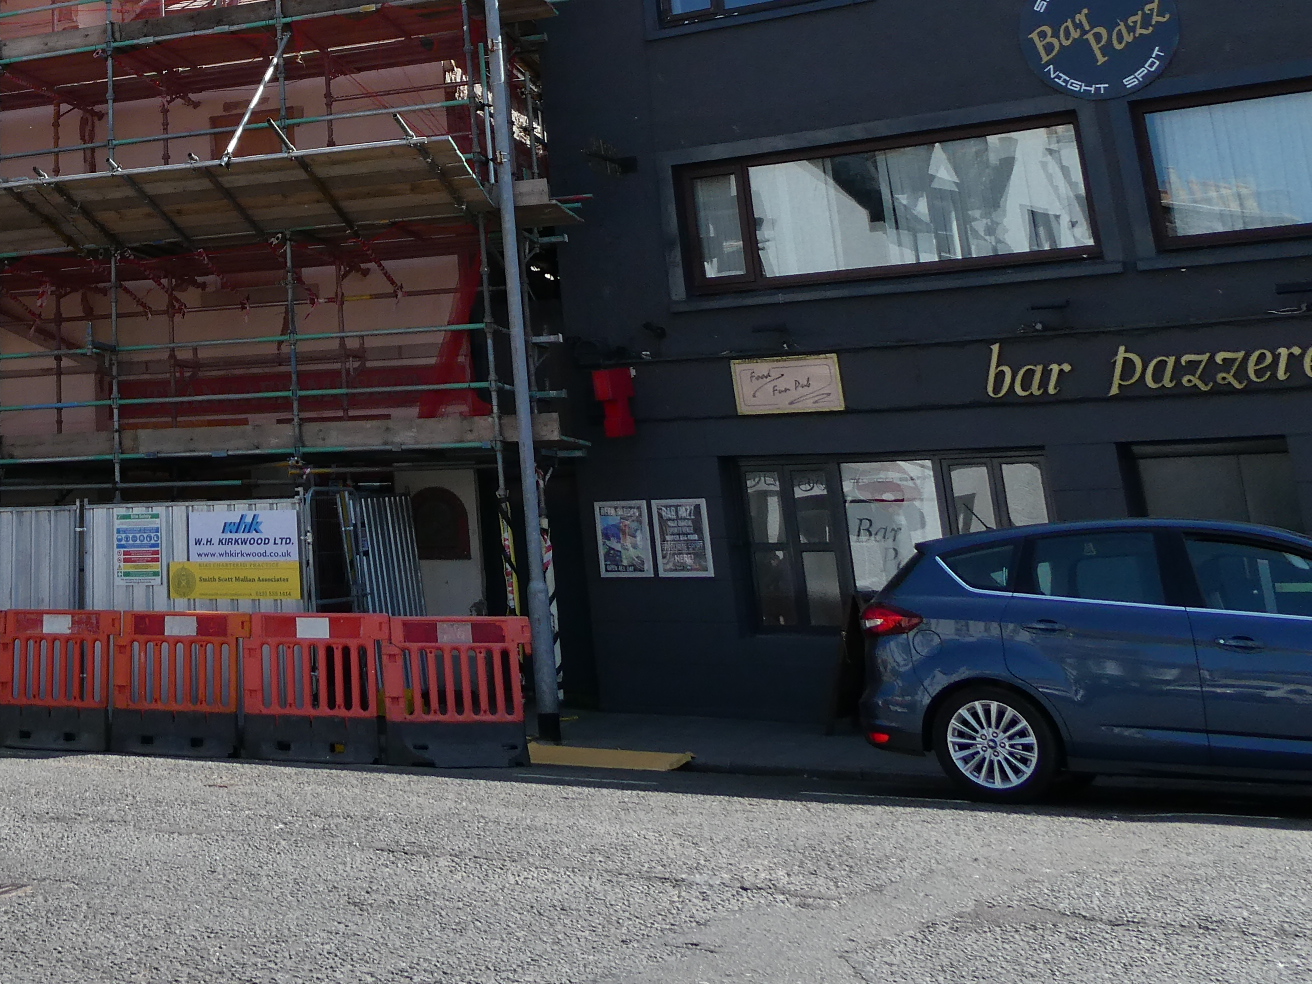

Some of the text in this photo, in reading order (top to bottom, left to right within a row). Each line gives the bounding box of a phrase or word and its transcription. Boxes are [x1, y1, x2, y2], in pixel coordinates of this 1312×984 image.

[1028, 7, 1091, 64] Bar
[1044, 46, 1165, 94] NIGHT SPOT
[986, 342, 1072, 399] bar
[221, 513, 263, 534] whk
[856, 517, 902, 543] Bar
[194, 536, 294, 546] W.H. KIRKWOOD LTD.
[196, 549, 292, 558] www.whkirkwood.co.uk
